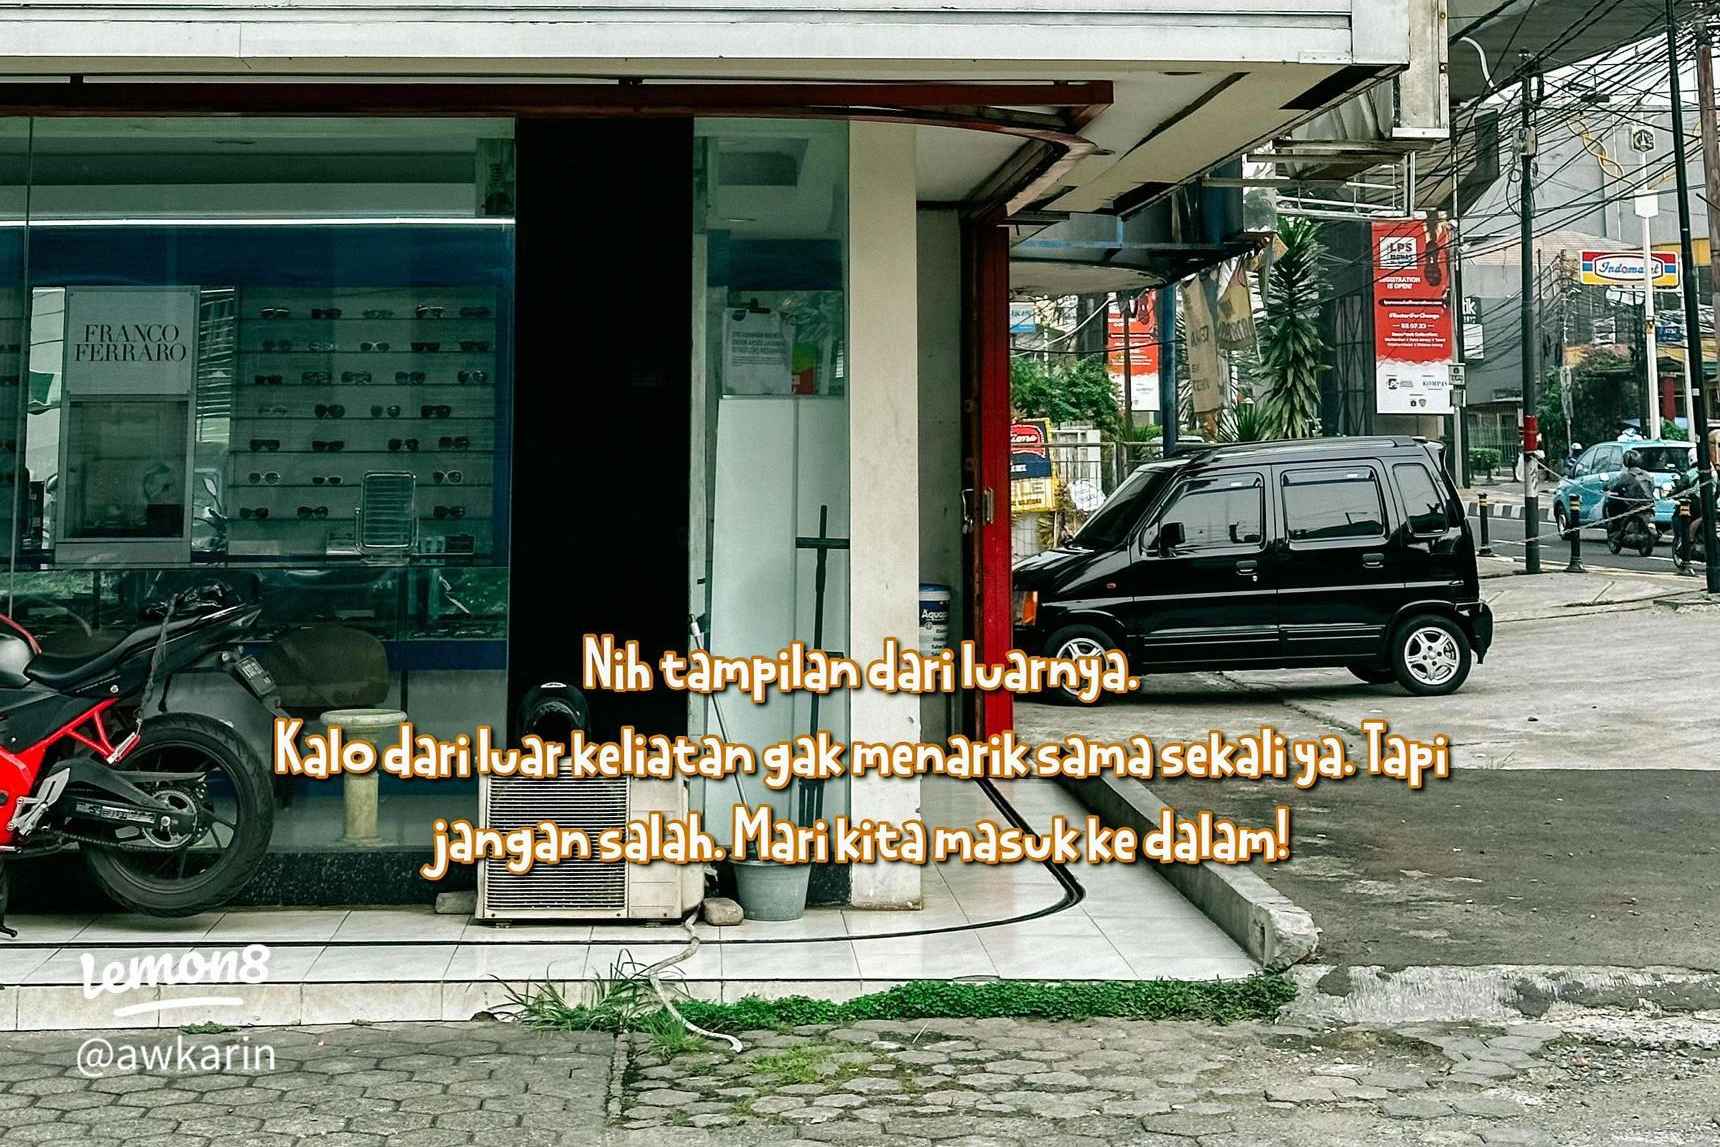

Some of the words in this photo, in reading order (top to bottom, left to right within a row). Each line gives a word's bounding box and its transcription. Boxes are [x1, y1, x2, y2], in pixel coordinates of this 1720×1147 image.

[1390, 242, 1413, 252] LPS
[1598, 261, 1660, 274] Indomat
[84, 323, 179, 343] FRANCO
[74, 343, 187, 362] FERRARO
